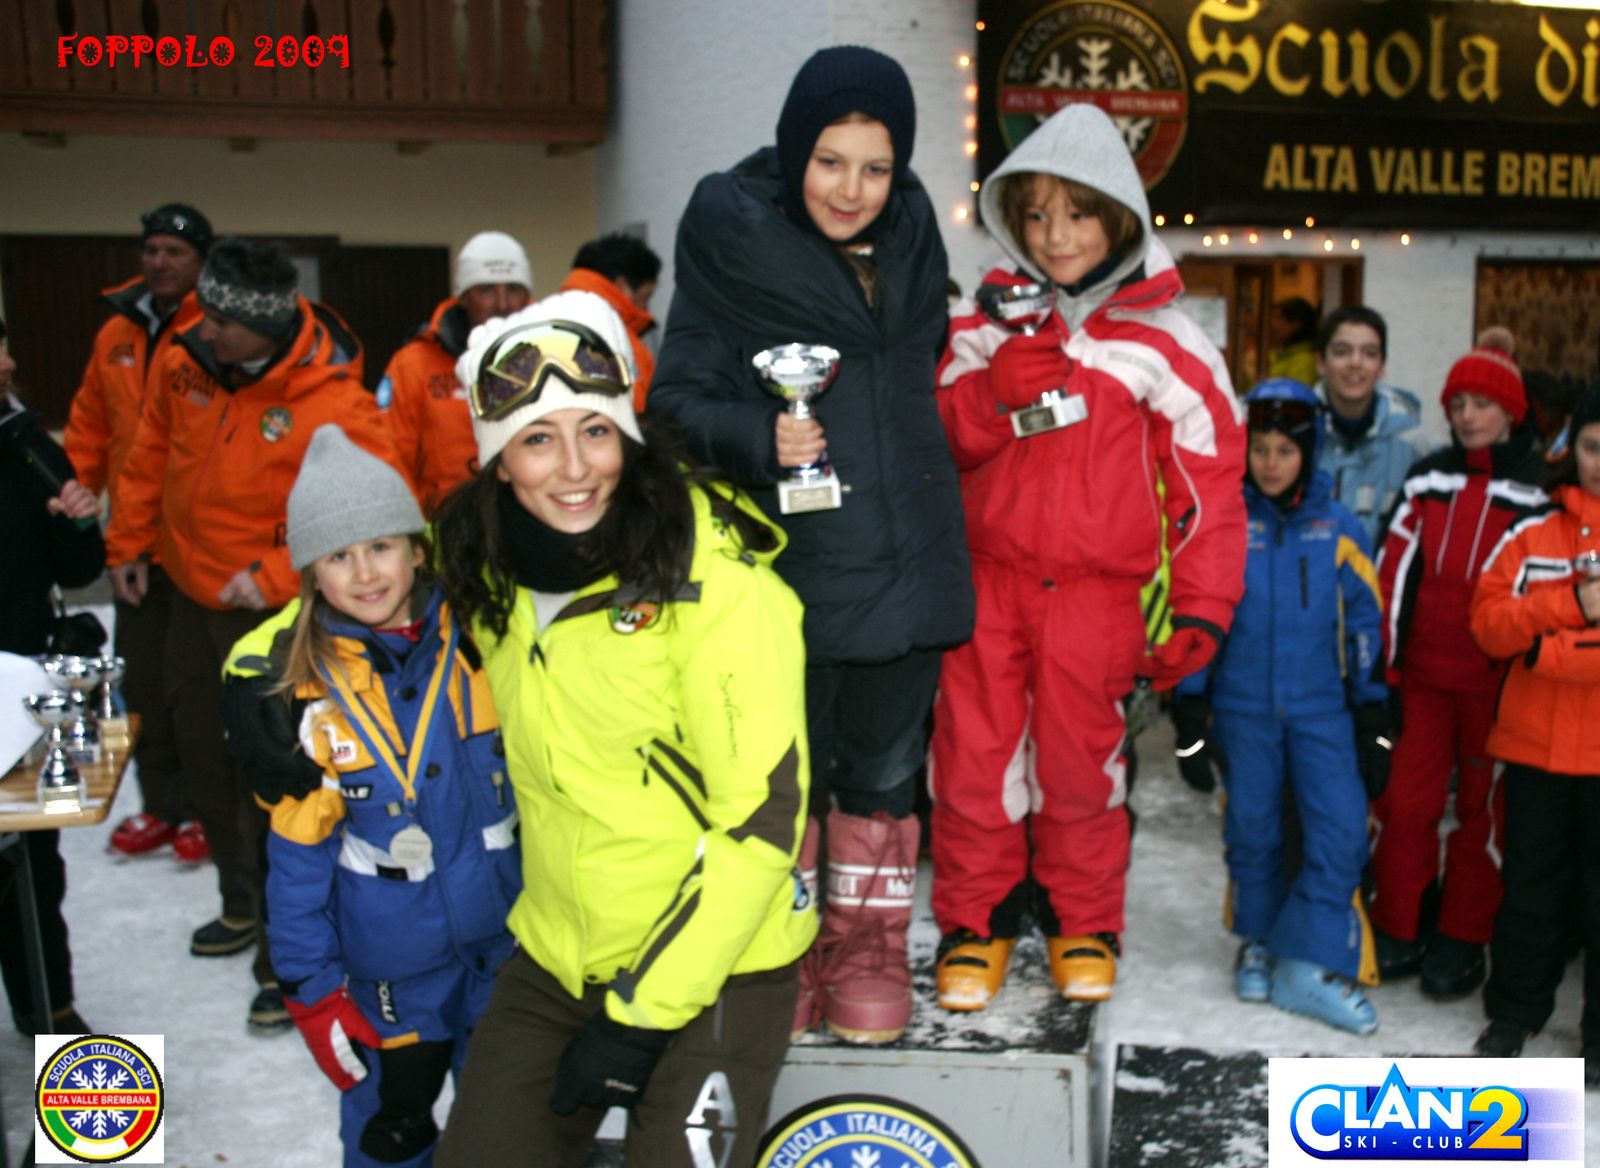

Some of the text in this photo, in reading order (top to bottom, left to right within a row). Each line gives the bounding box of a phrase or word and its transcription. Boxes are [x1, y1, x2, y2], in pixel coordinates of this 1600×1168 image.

[1264, 144, 1600, 198] ALTA VALLE BREM
[768, 1113, 939, 1168] CUOLA ITALIANA
